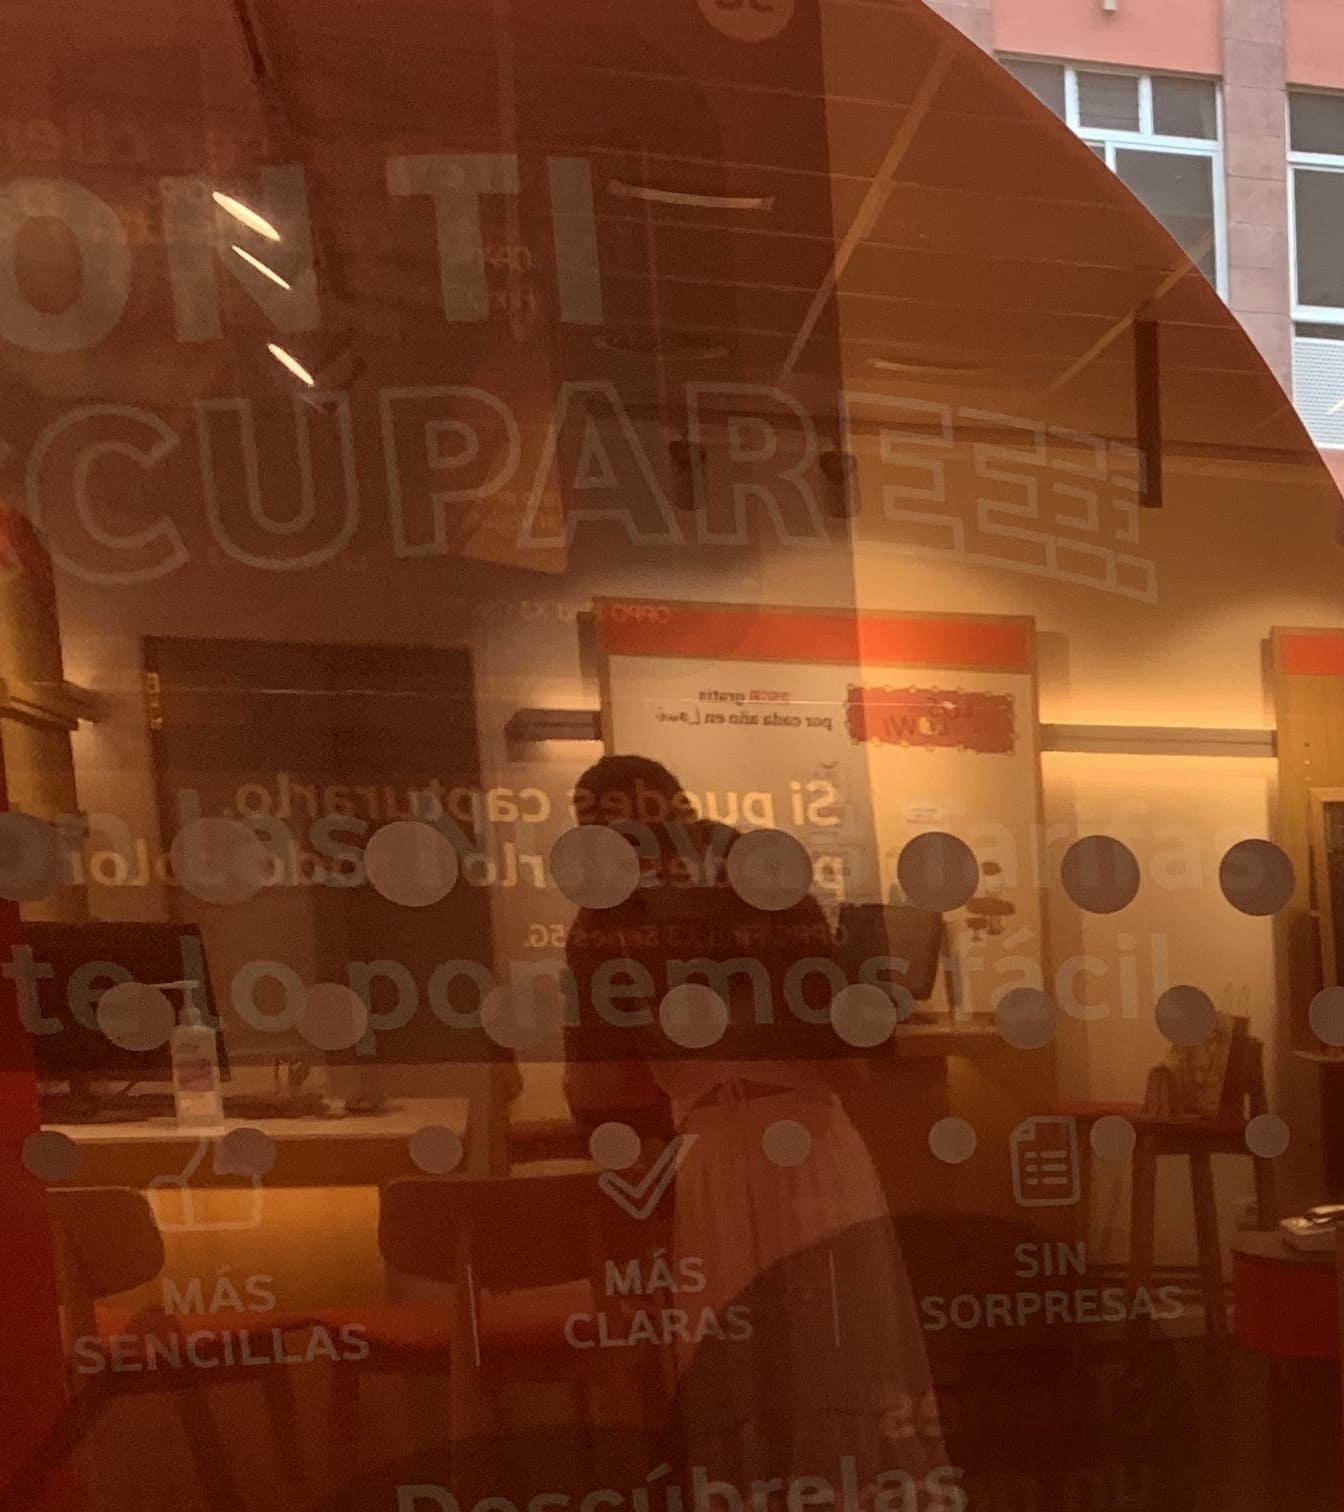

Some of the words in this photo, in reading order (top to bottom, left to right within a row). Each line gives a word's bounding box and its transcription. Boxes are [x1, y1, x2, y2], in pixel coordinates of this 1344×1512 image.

[385, 153, 602, 325] TI
[602, 1250, 707, 1298] MÁS
[1014, 1241, 1087, 1279] SIN
[160, 1273, 277, 1317] MÁS
[921, 1285, 1185, 1332] SORPRESAS
[72, 1322, 371, 1376] SENCILLAS
[563, 1303, 754, 1351] CLARAS
